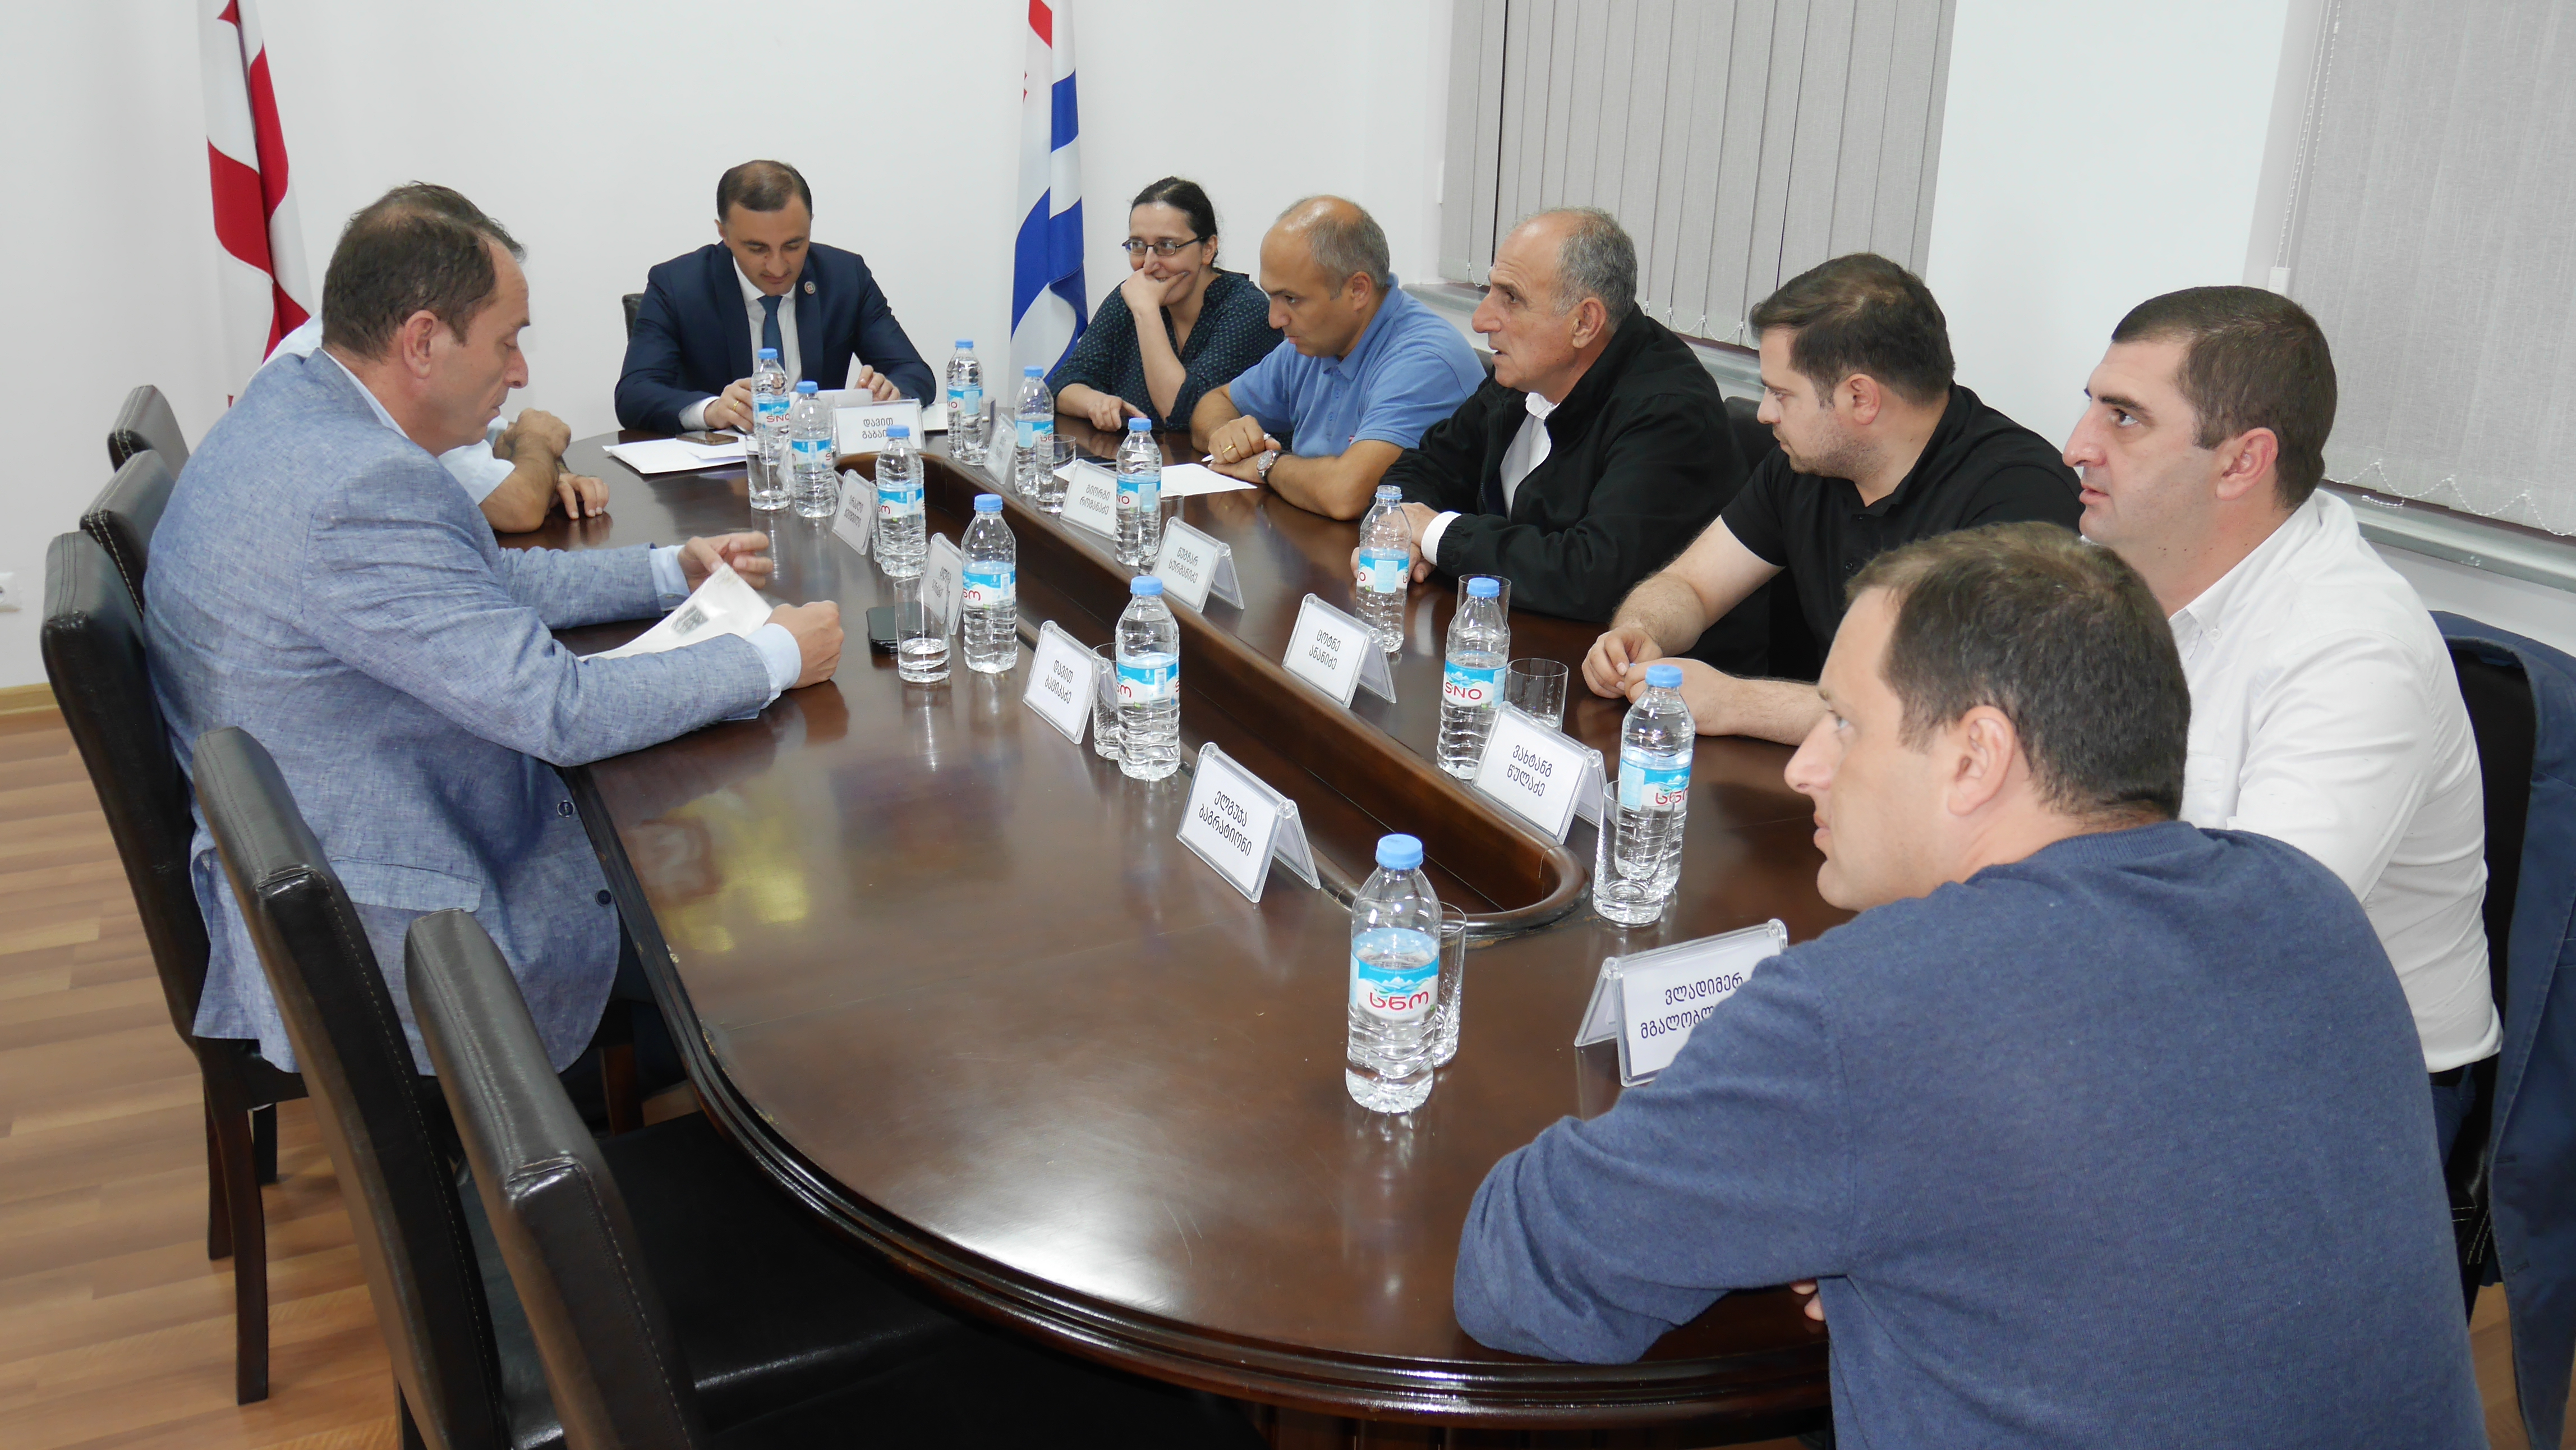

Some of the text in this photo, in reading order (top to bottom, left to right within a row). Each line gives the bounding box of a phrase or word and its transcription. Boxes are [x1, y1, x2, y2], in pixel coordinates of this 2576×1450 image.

[862, 429, 886, 439] გაბაი
[863, 417, 894, 427] დავით
[1086, 484, 1110, 501] გიორგი
[1116, 495, 1130, 504] NO
[1079, 496, 1110, 515] რომანაძე
[1177, 547, 1198, 567] ნუგზარ
[1168, 558, 1198, 584] სურმანიძე
[1316, 629, 1341, 651] ცოტნე
[1309, 645, 1337, 670] ანანიძე
[1053, 659, 1074, 684] დავით
[1045, 674, 1072, 704] ბაციკაძე
[1445, 682, 1483, 700] SNO
[1512, 745, 1552, 777] ვახტანგ
[1507, 764, 1545, 797] წულაძე
[1214, 791, 1248, 827] ელგუჯა
[1199, 803, 1252, 856] ბაგრატიონი
[1369, 991, 1429, 1011] სნო
[1665, 972, 1744, 1005] ვლადიმერ
[1640, 1006, 1714, 1039] მგალობლ
